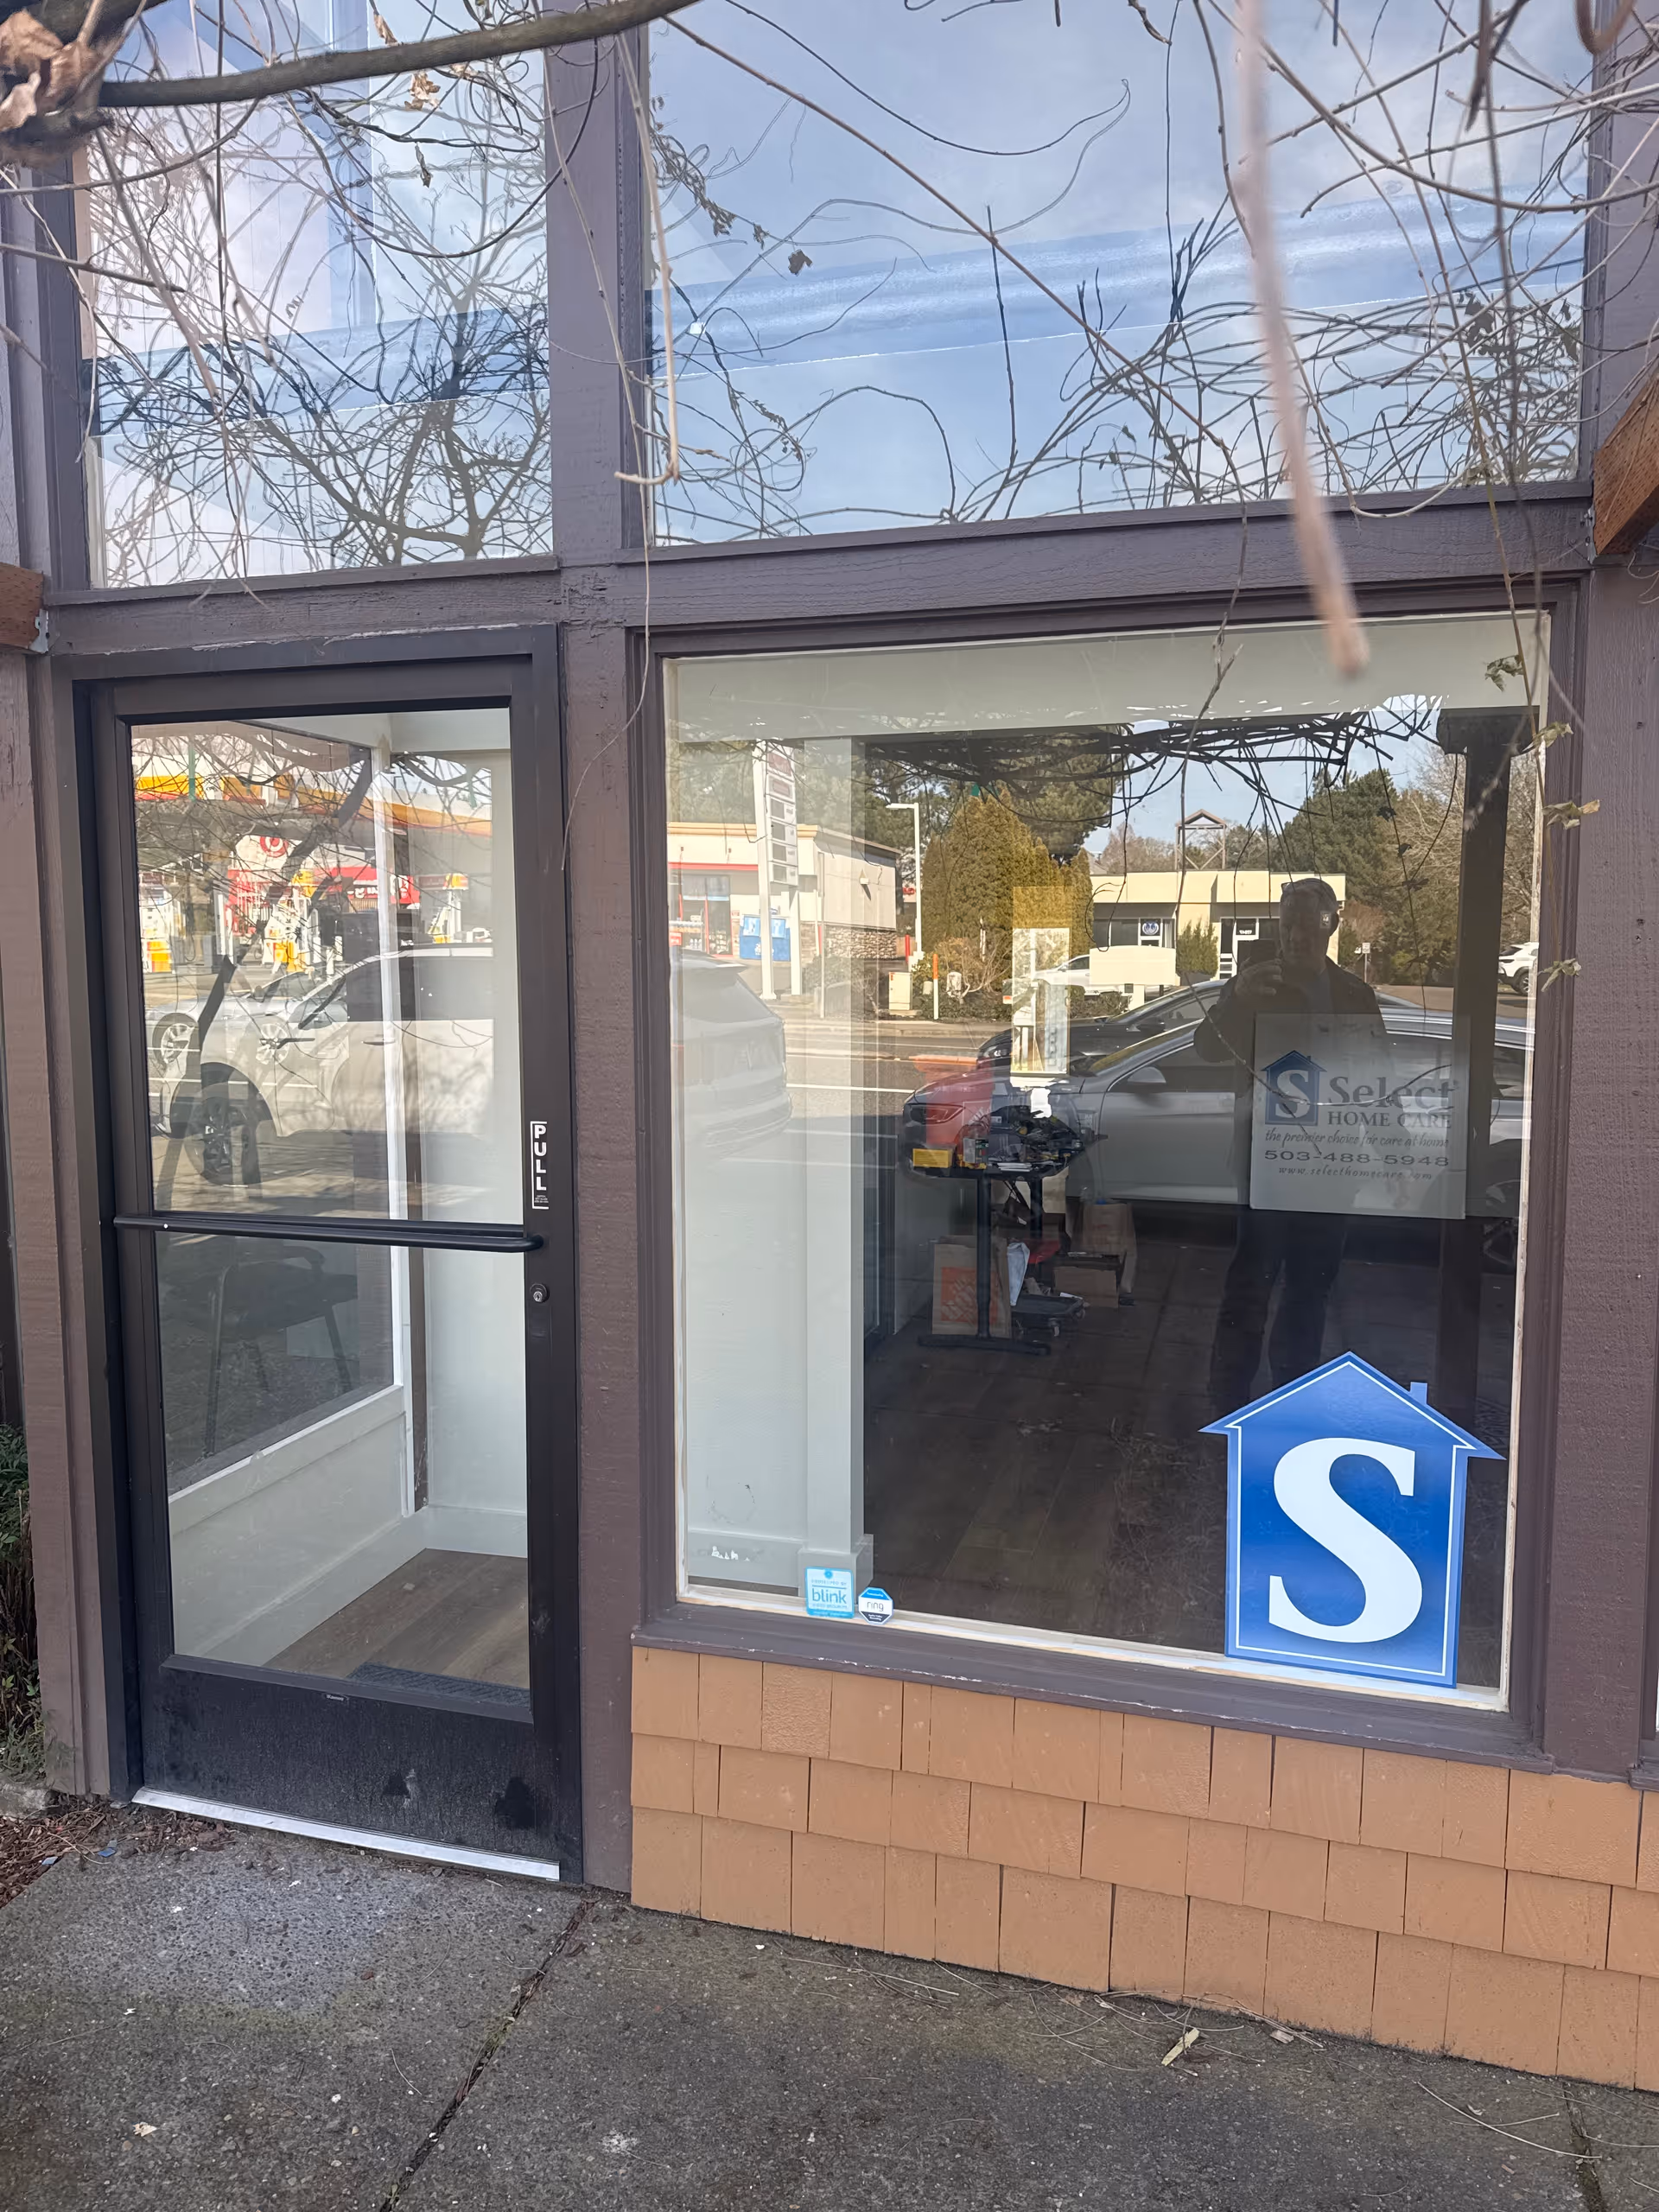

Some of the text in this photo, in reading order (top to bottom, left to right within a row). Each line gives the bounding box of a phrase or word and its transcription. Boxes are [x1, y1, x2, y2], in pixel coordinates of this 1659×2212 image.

[1274, 1068, 1312, 1119] S
[1328, 1075, 1454, 1110] Select
[1327, 1110, 1452, 1129] HOME CARE
[1265, 1128, 1281, 1142] the
[1282, 1129, 1326, 1148] premier
[1327, 1129, 1359, 1145] choice
[1359, 1130, 1379, 1147] for
[1380, 1135, 1402, 1147] care
[1403, 1135, 1418, 1148] at
[533, 1124, 547, 1191] PULL
[1264, 1149, 1449, 1166] 503-488-5948
[1268, 1437, 1423, 1643] S
[812, 1588, 847, 1605] blink
[867, 1601, 884, 1613] ring
